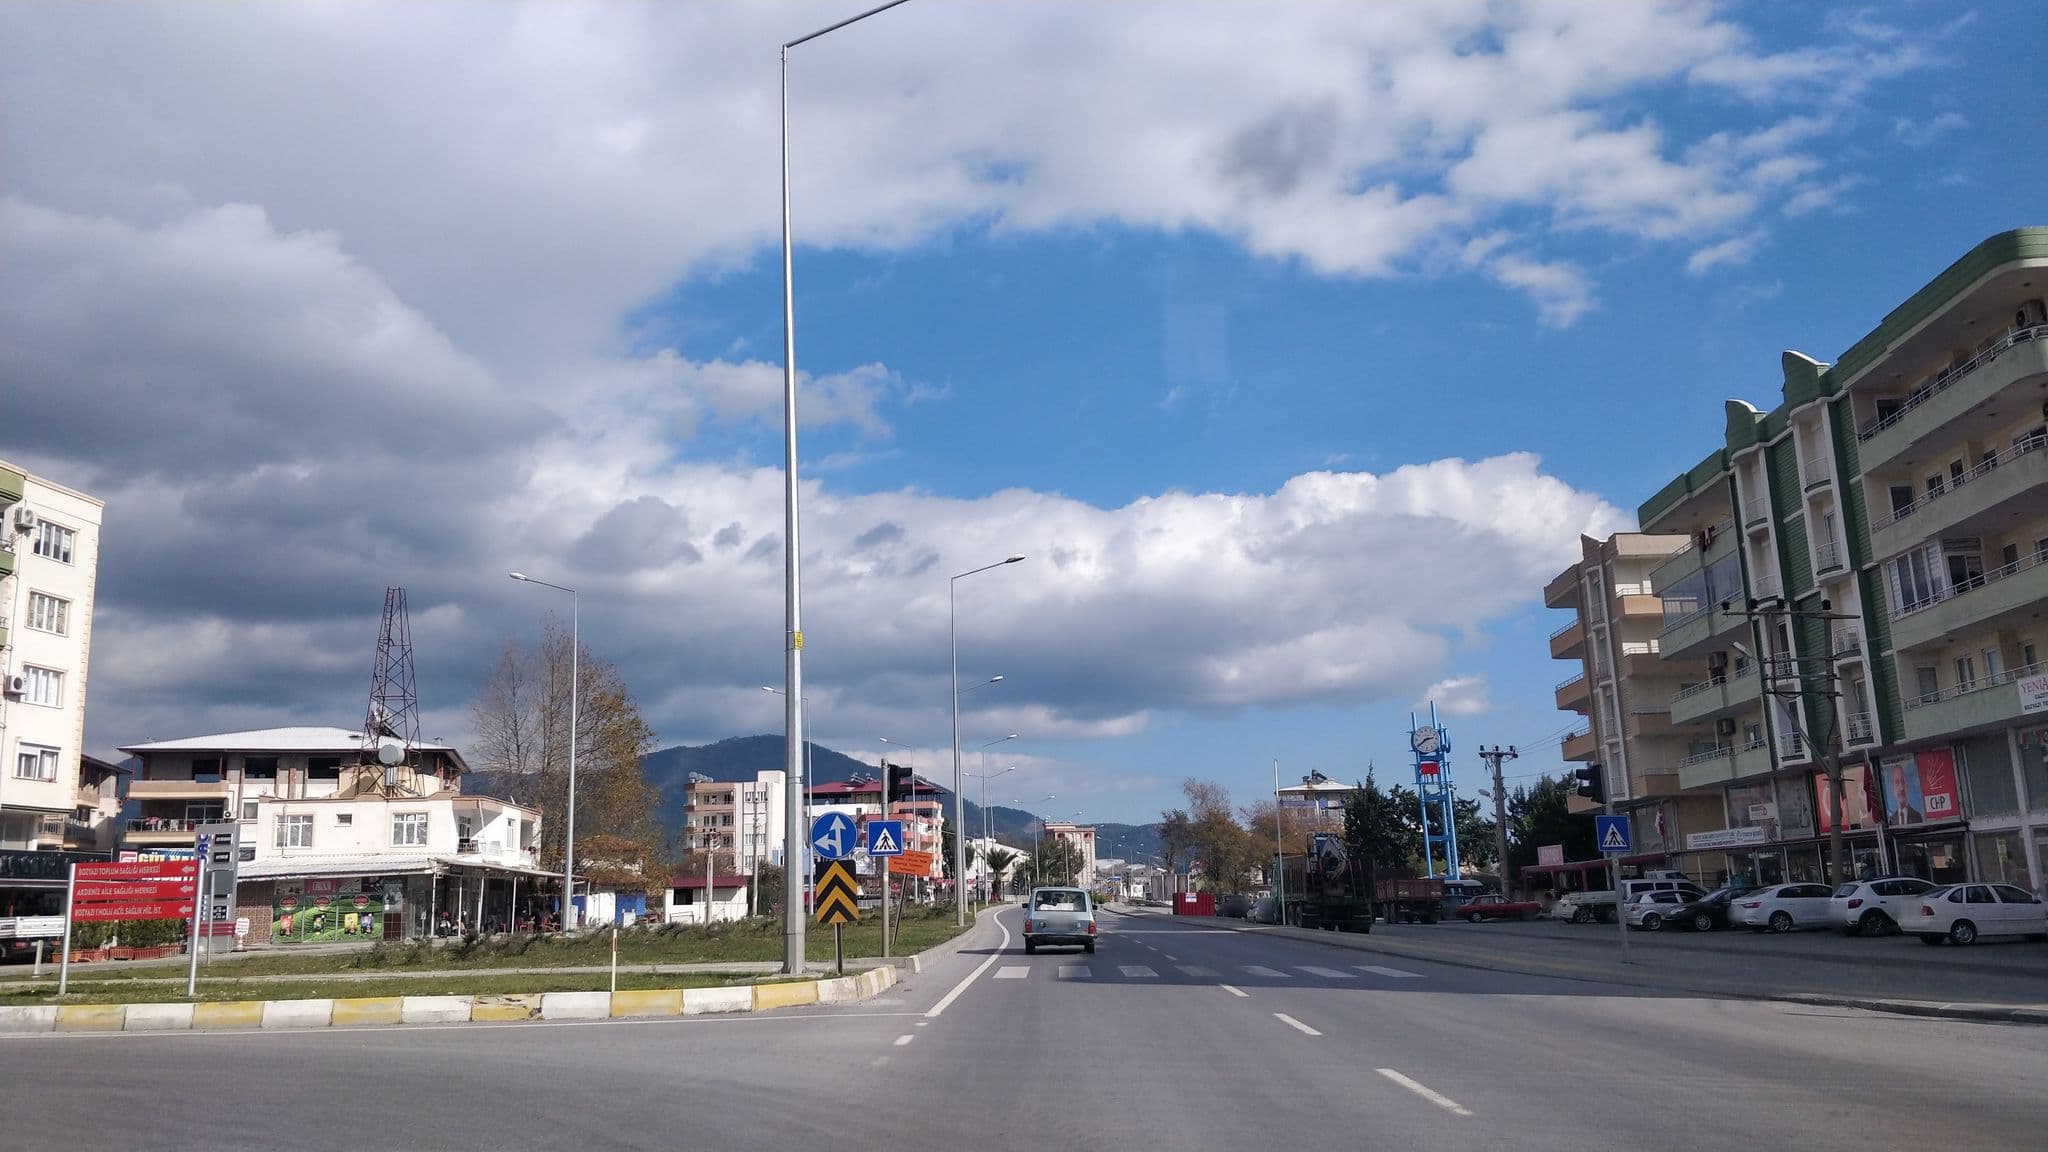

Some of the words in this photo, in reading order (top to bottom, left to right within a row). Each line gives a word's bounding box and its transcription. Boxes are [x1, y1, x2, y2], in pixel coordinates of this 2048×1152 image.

[1930, 796, 1946, 810] CHP
[79, 868, 99, 876] BOZYAZI
[100, 867, 118, 876] TOPLUM
[119, 865, 138, 875] SAĞLIĞI
[139, 864, 161, 874] MERKEZİ
[77, 887, 101, 896] AKDENİZ
[101, 886, 113, 895] AİLE
[113, 885, 134, 895] SAĞLIĞI
[134, 884, 158, 894] MERKEZİ
[75, 907, 95, 917] BOZYAZI
